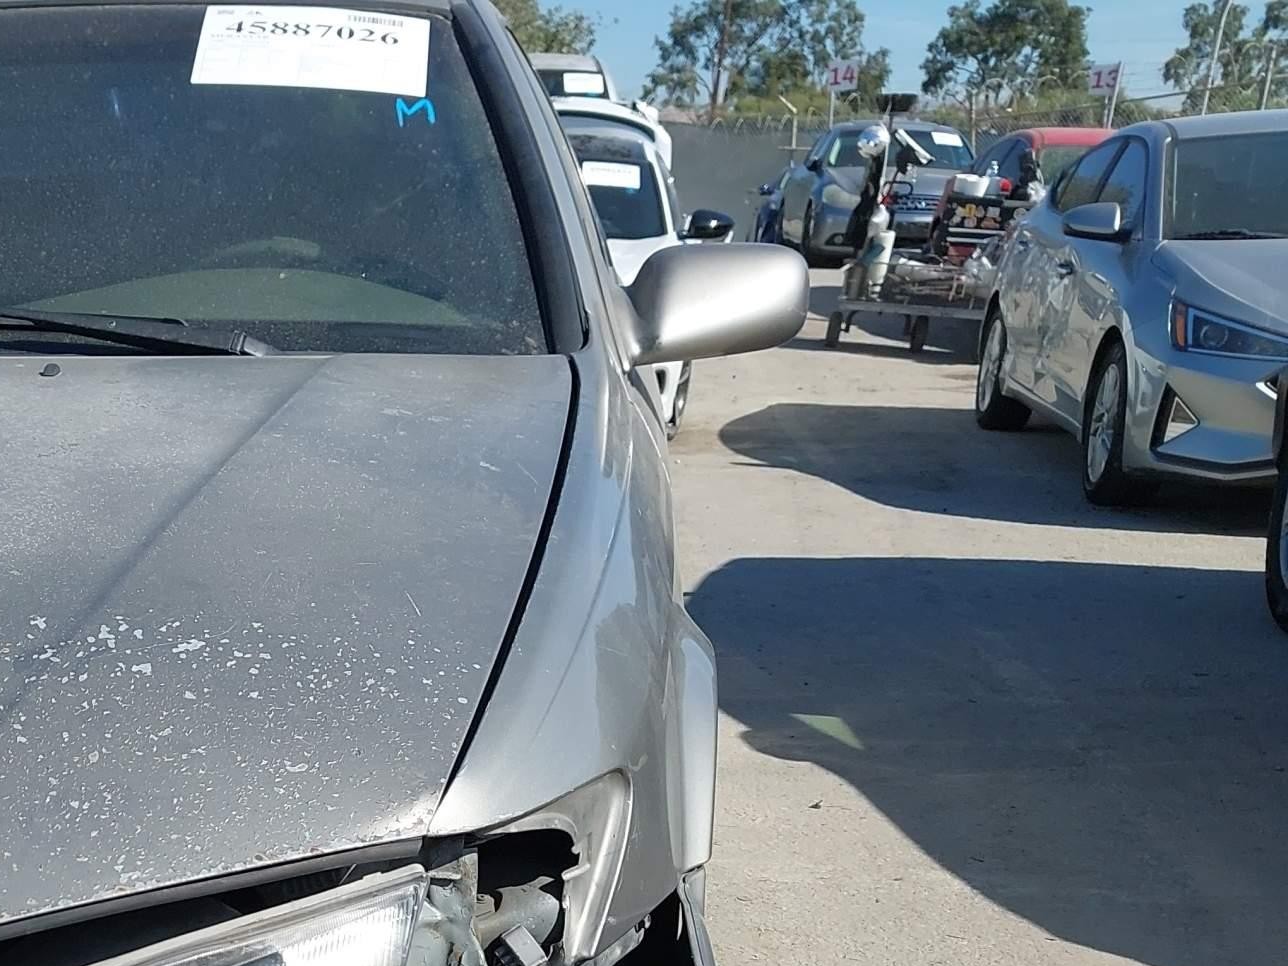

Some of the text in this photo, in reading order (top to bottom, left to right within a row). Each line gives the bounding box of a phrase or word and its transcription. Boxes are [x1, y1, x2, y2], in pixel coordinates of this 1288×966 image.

[226, 20, 400, 46] 45887026
[830, 65, 856, 86] 14
[1092, 69, 1119, 88] 13
[396, 97, 436, 127] M
